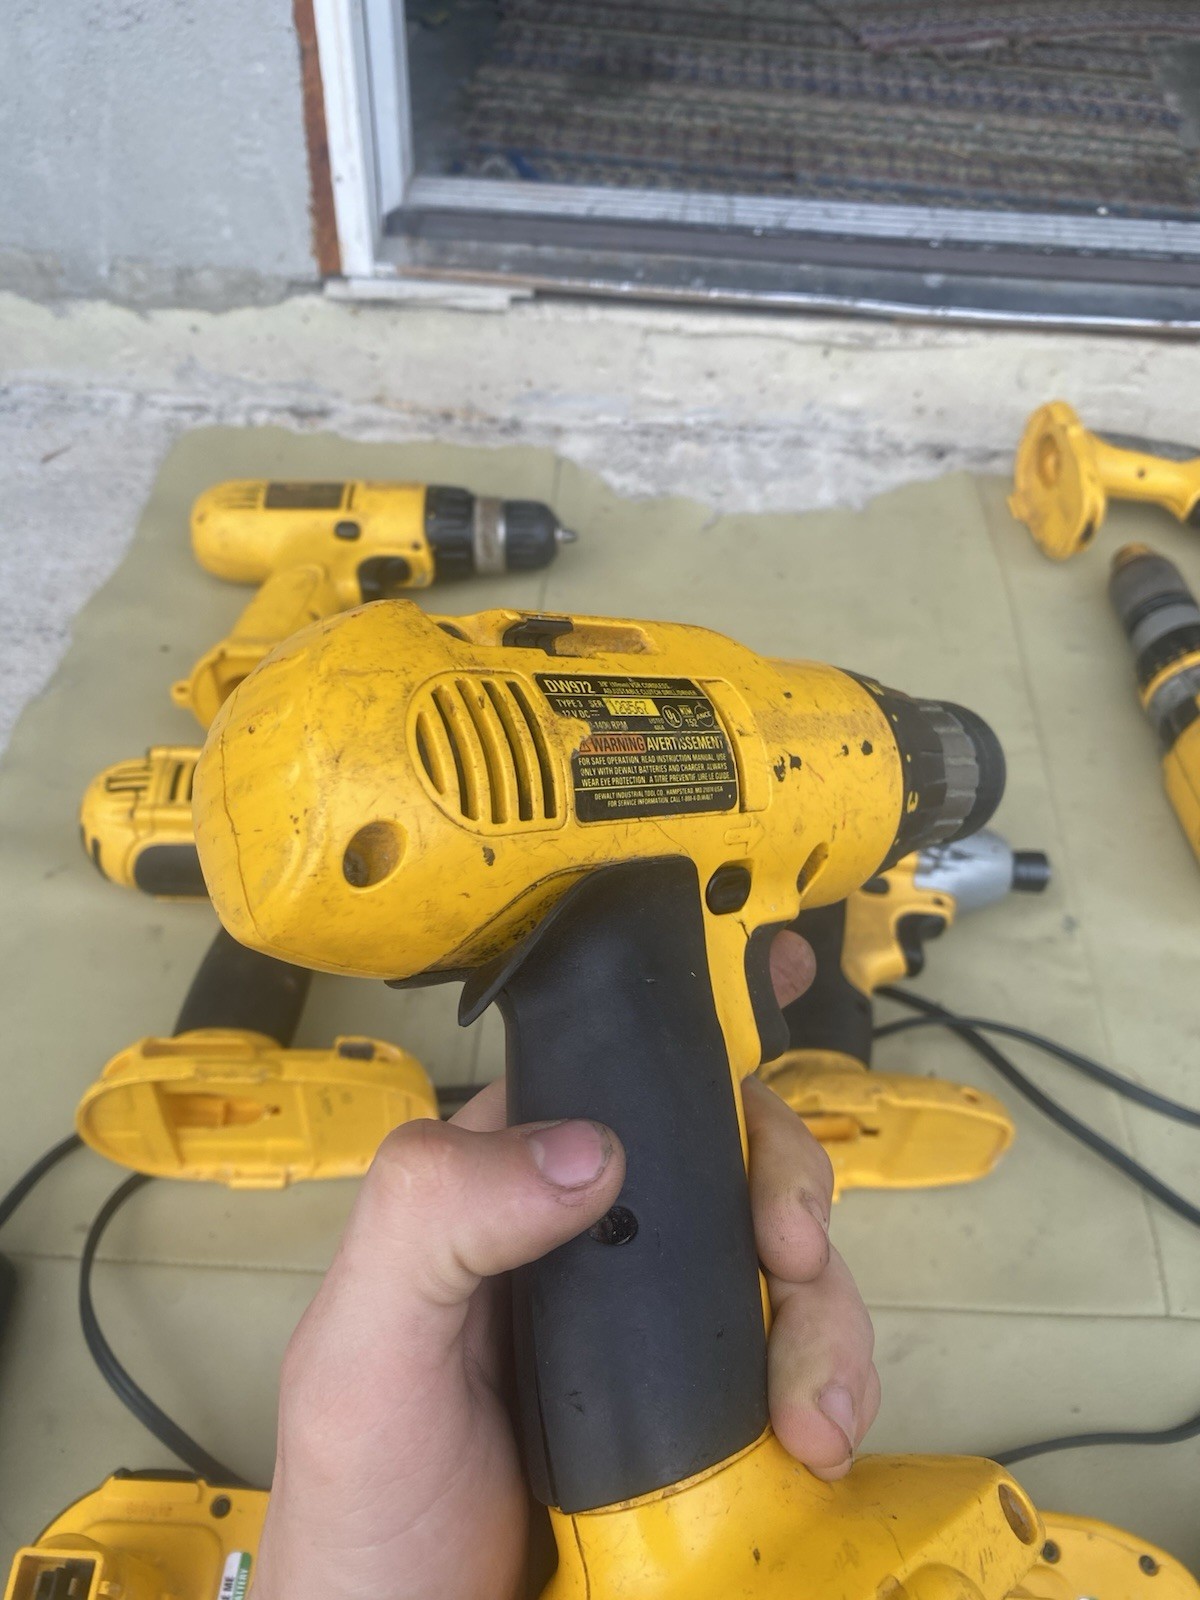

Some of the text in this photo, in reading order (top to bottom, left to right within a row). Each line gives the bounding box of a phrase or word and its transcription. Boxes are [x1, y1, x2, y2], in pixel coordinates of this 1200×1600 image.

[543, 679, 596, 694] DW972
[556, 698, 577, 708] TYPE
[571, 710, 578, 718] V
[579, 710, 591, 719] DC
[591, 737, 645, 752] WARNING
[647, 735, 724, 751] AVERTISSEMENT
[578, 757, 591, 766] FOR
[591, 757, 606, 765] SAFE
[640, 755, 656, 763] READ
[656, 754, 692, 763] INSTRUCTION
[580, 767, 597, 776] ONLY
[597, 767, 613, 776] WITH
[638, 764, 667, 774] BATTERIES
[668, 764, 680, 772] AND
[706, 762, 728, 771] ALWAYS
[581, 778, 599, 787] WEAR
[600, 777, 611, 786] EYE
[615, 790, 644, 799] INDUSTRIAL
[607, 800, 617, 808] FOR
[618, 799, 637, 807] SERVICE
